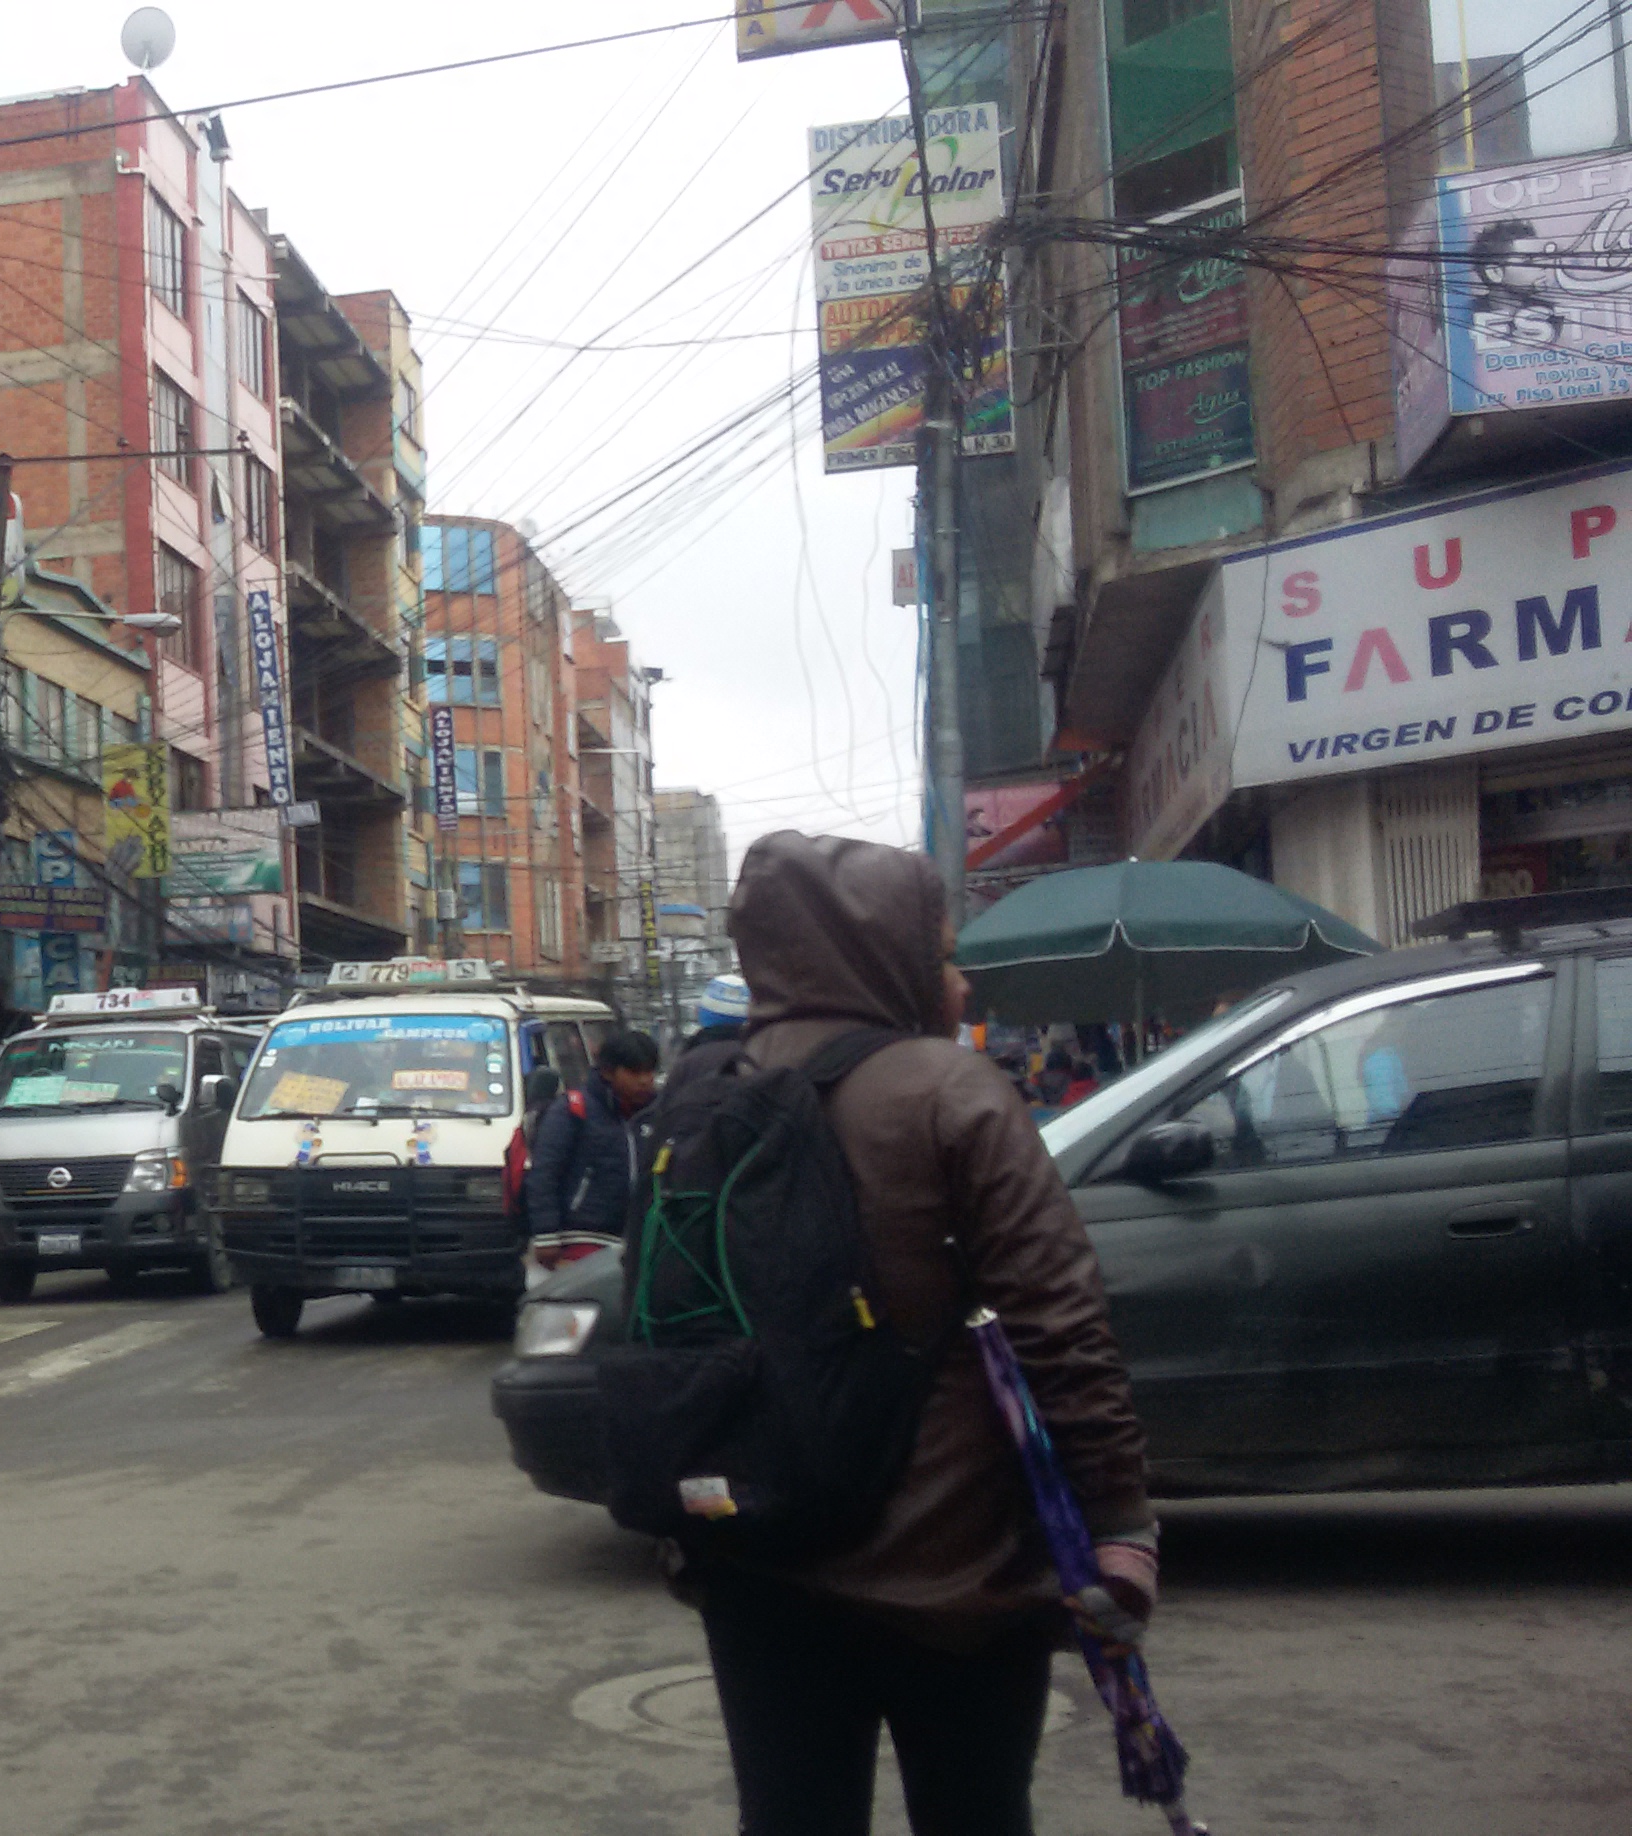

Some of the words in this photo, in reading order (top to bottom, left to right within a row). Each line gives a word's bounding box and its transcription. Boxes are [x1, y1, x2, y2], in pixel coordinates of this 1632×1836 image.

[1135, 370, 1171, 392] TOP
[1175, 349, 1247, 379] FASHION
[1535, 365, 1599, 384] novias
[1284, 583, 1632, 704] FARM
[251, 592, 289, 803] ALOJAMIENTO
[1286, 715, 1458, 765] VIRGEN
[1471, 702, 1537, 736] DE
[1553, 689, 1632, 722] CO
[370, 963, 410, 983] 779
[97, 993, 131, 1010] 734
[308, 1017, 392, 1033] BOLIVAR
